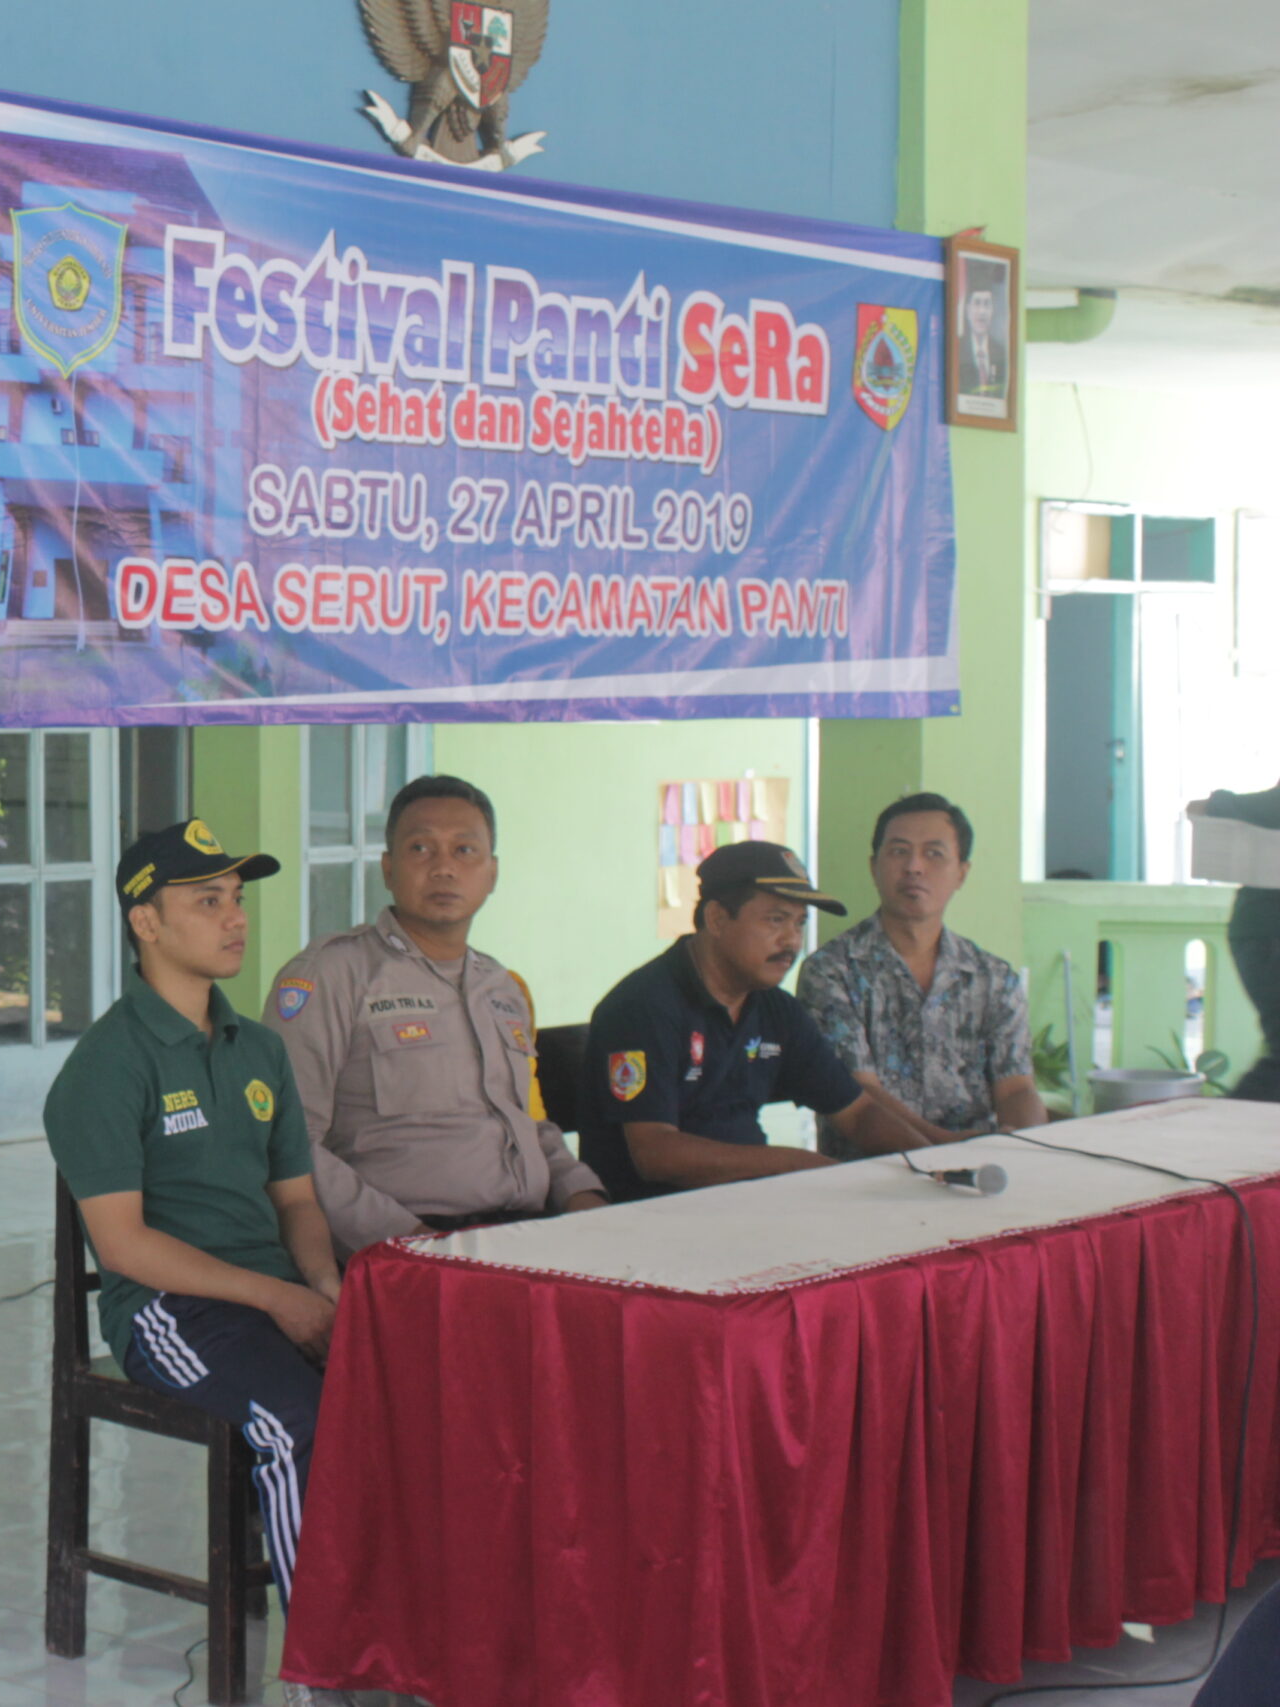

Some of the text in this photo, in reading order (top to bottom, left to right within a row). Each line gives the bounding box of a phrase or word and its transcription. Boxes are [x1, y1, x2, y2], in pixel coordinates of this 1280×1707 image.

[164, 224, 474, 383] Festival
[483, 264, 671, 400] Panti
[675, 290, 830, 416] SeRa
[311, 368, 721, 476] (Sehat dan SejahteRa)
[248, 463, 753, 554] SABTU, 27 APRIL 2019
[115, 556, 850, 645] DESA SERUT, KECAMATAN PANTI
[369, 999, 397, 1014] YUDI
[397, 997, 415, 1010] TRI
[162, 1089, 199, 1113] NERS
[163, 1107, 210, 1136] MUDA
